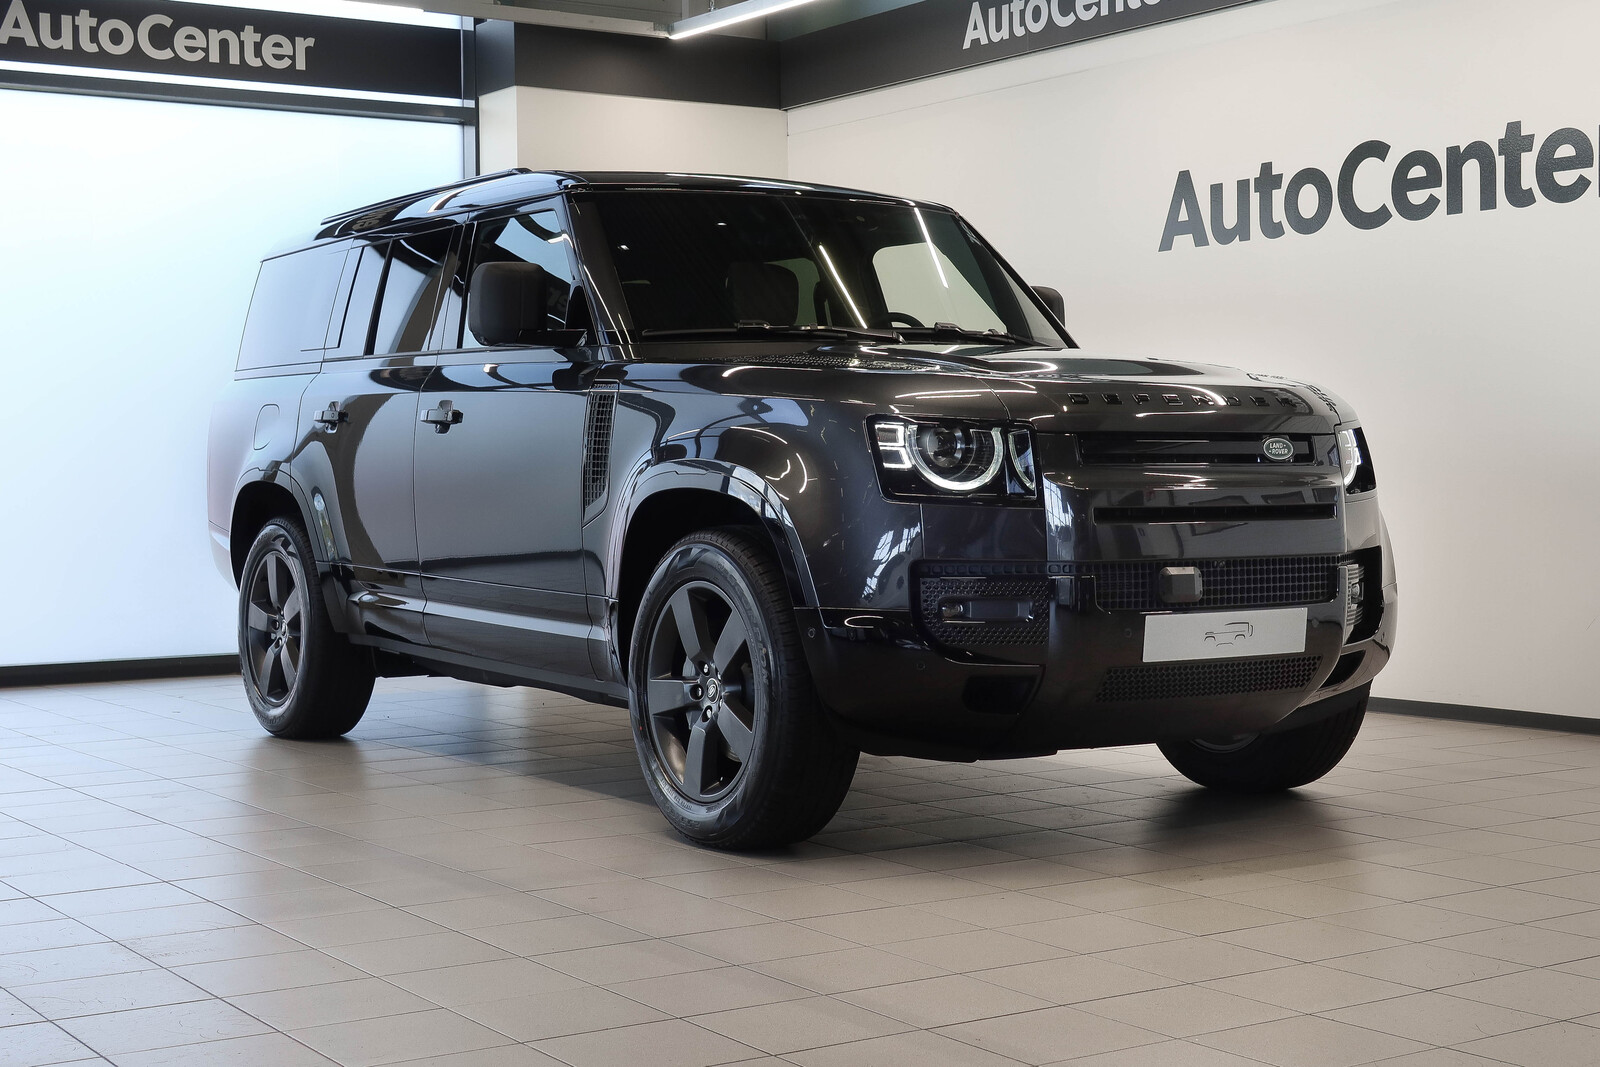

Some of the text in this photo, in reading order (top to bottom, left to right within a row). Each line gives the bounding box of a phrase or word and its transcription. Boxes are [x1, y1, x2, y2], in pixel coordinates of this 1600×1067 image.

[0, 0, 316, 71] AutoCenter
[962, 0, 1162, 50] AutoCe
[1159, 121, 1600, 252] AutoCente
[1067, 392, 1298, 407] DEFENDER
